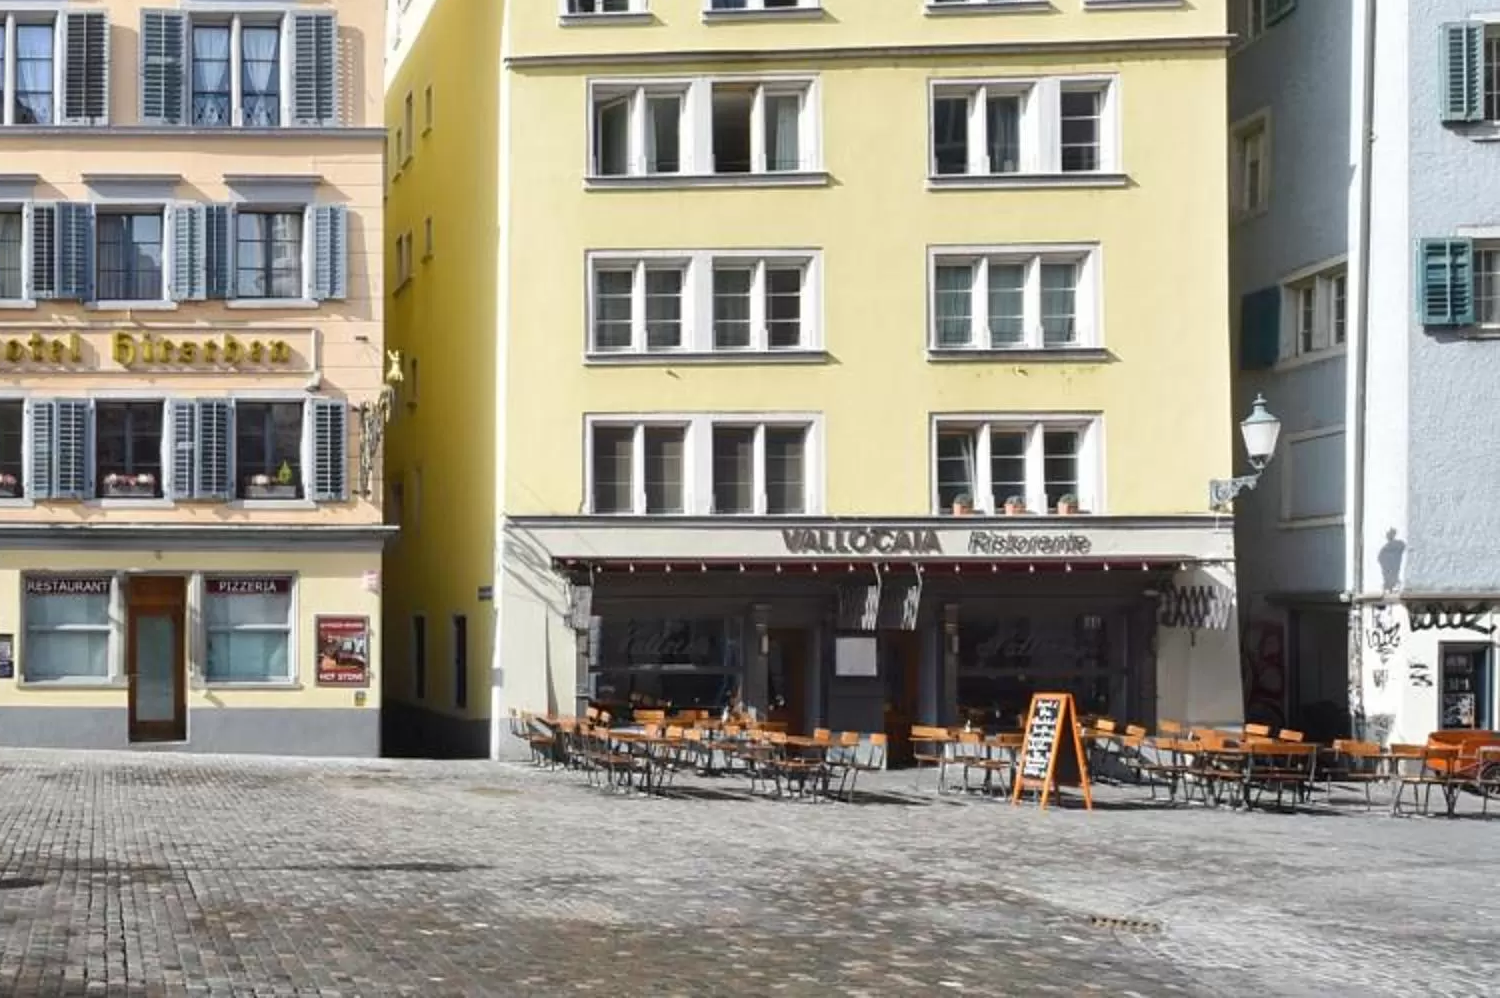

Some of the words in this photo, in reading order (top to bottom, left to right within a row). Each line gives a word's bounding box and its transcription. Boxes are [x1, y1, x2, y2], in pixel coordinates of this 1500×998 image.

[781, 527, 943, 553] VALLOCAIA
[26, 580, 109, 593] RESTAURANT
[218, 580, 277, 592] PIZZERIA
